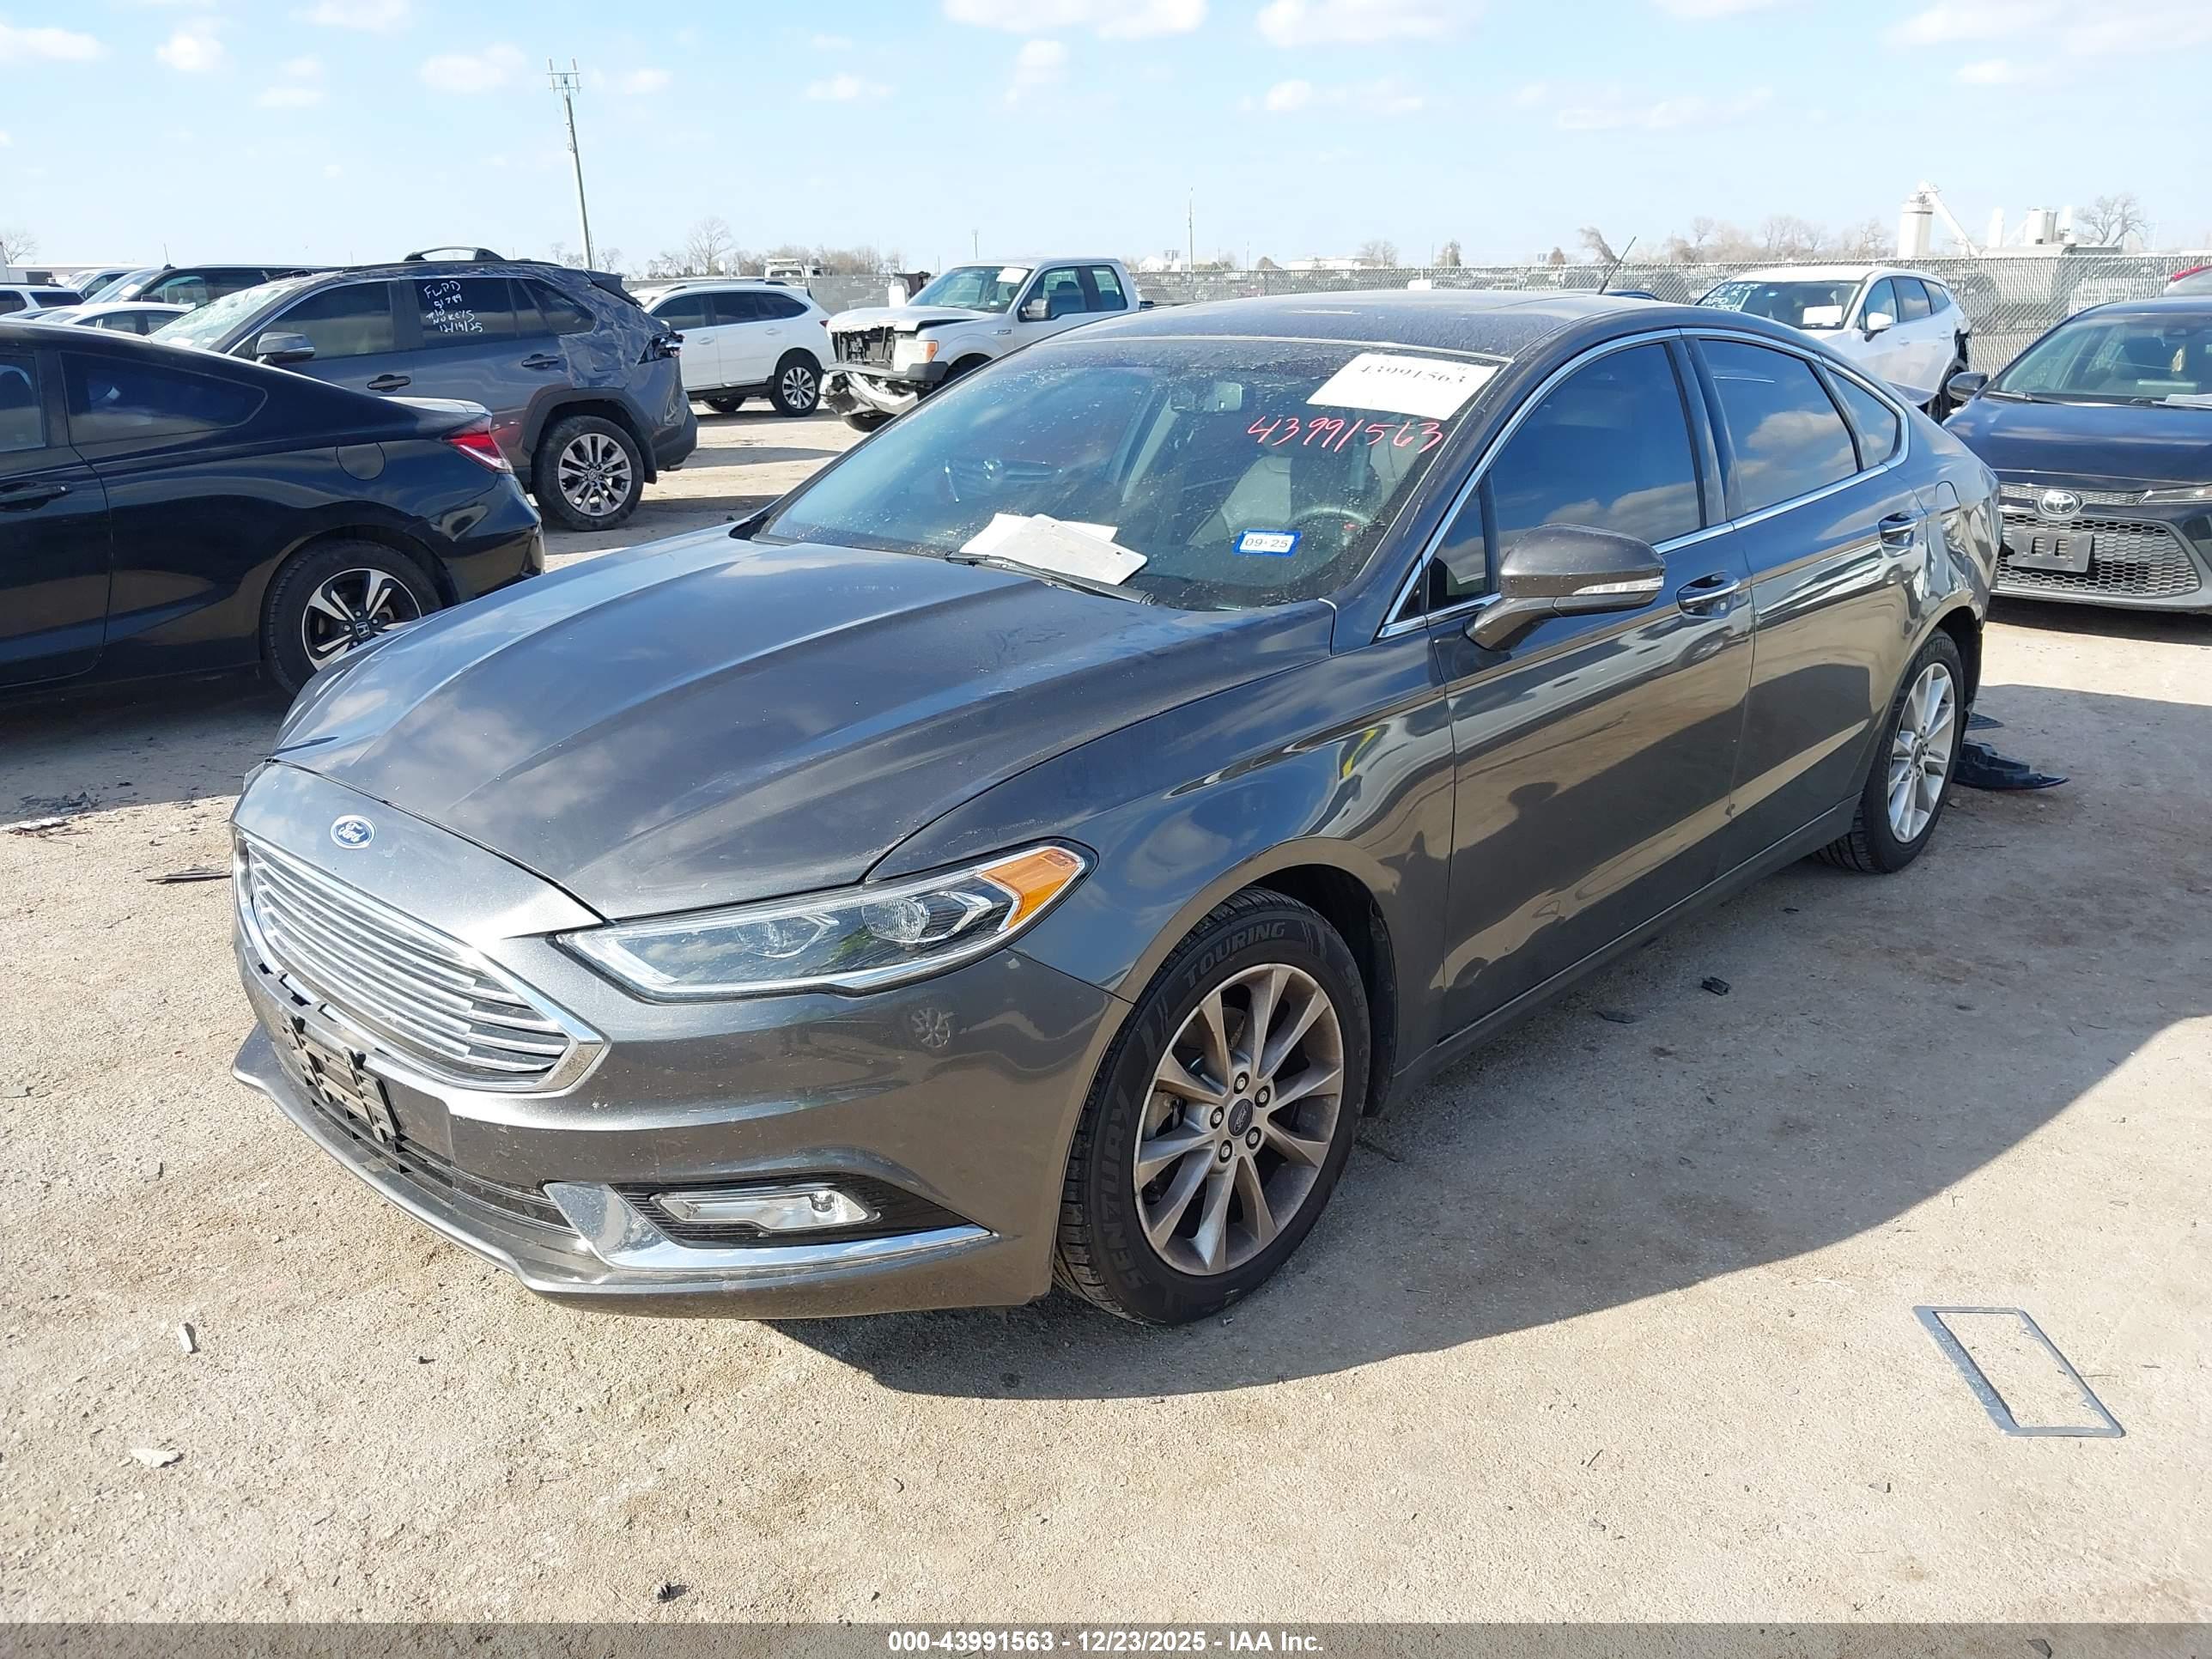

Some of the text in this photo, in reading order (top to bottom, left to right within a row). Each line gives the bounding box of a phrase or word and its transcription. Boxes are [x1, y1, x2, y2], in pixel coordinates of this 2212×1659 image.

[1247, 416, 1444, 453] 43991563
[337, 822, 366, 842] Ford
[1187, 922, 1285, 988] TOURING
